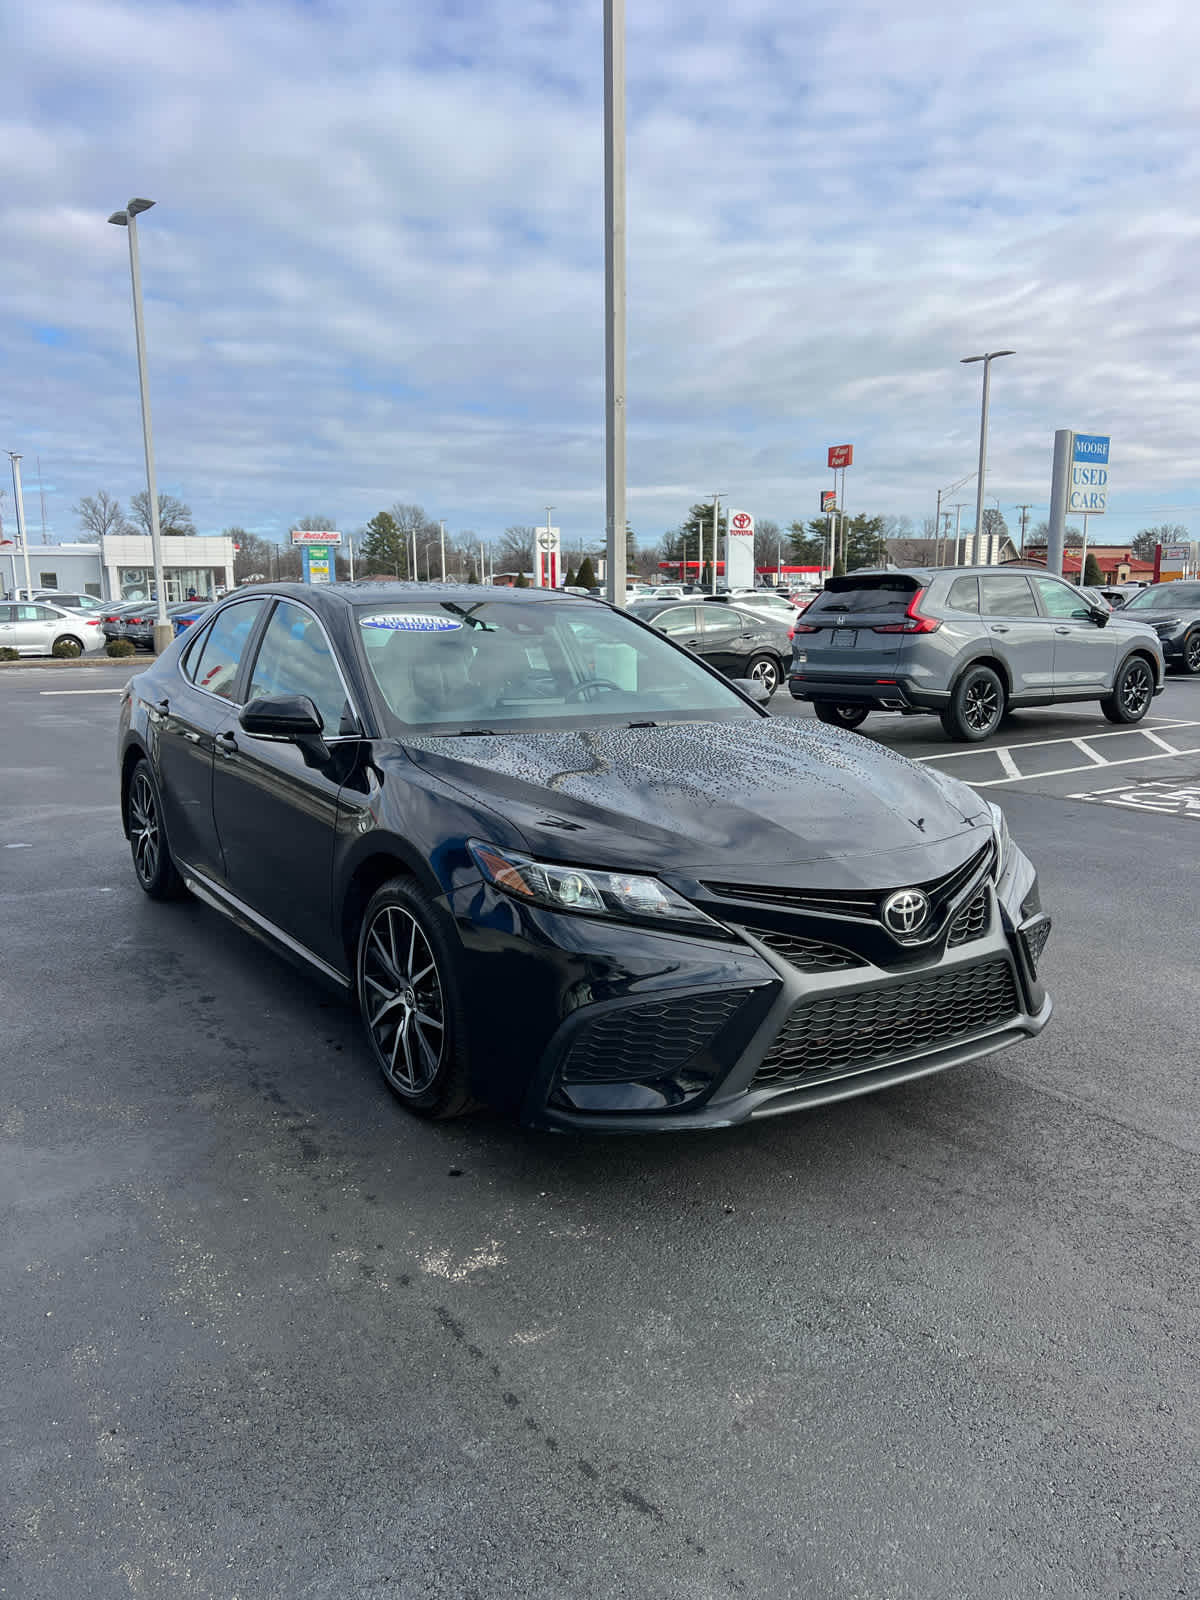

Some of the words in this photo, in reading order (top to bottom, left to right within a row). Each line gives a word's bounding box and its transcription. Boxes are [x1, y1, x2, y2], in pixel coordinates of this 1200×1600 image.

[1076, 441, 1108, 455] MOORE
[1073, 467, 1108, 486] USED
[1071, 491, 1106, 509] CARS
[303, 532, 339, 540] AutoZone
[729, 529, 753, 537] TOYOTA
